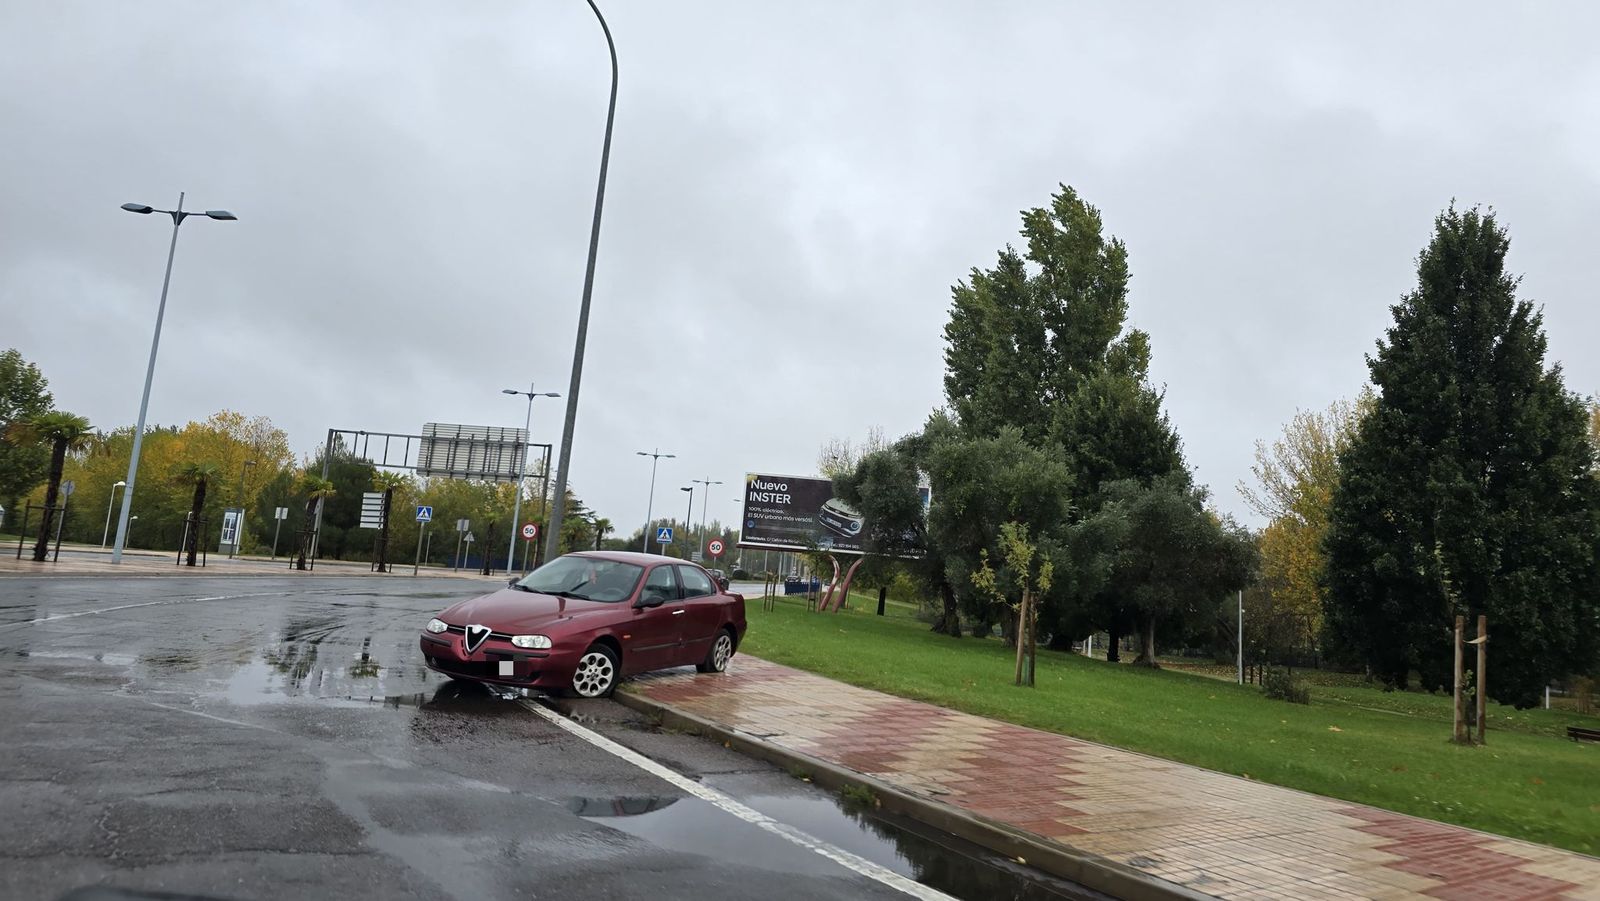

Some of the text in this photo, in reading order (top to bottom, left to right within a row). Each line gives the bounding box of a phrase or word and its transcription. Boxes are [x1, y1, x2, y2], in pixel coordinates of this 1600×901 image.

[751, 480, 788, 491] Nuevo
[749, 491, 791, 504] INSTER
[525, 527, 534, 535] 50
